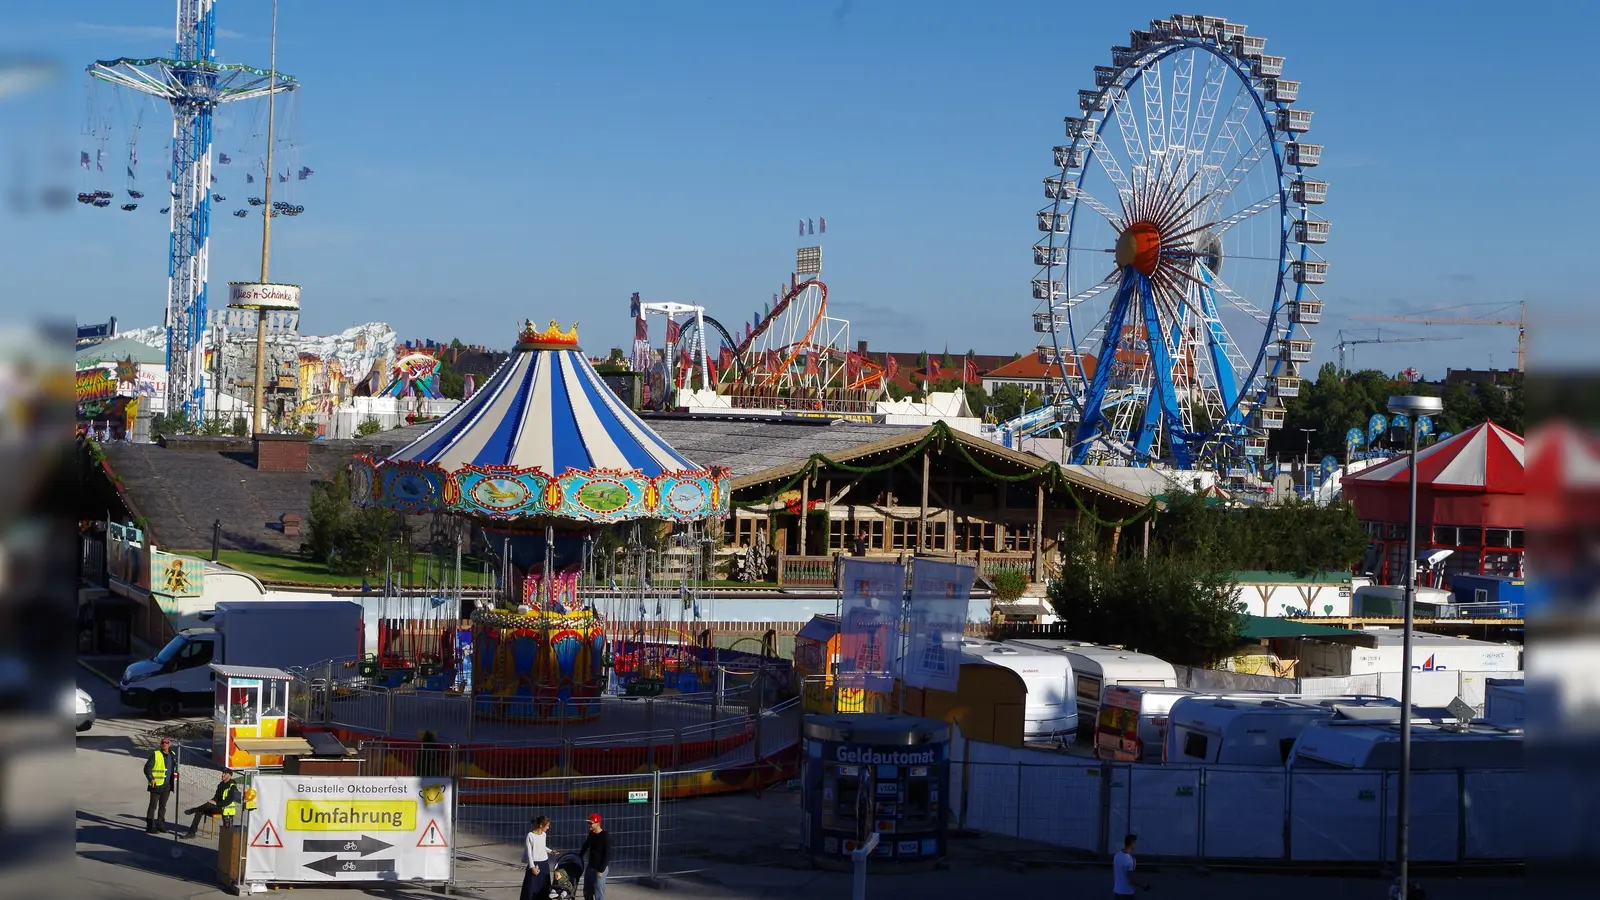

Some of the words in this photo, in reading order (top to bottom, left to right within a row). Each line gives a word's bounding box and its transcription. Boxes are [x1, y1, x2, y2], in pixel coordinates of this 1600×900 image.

[837, 746, 934, 764] Geldautomat
[297, 784, 344, 793] Baustelle
[347, 784, 408, 794] Oktoberfest
[300, 807, 403, 827] Umfahrung
[900, 843, 917, 851] VISA
